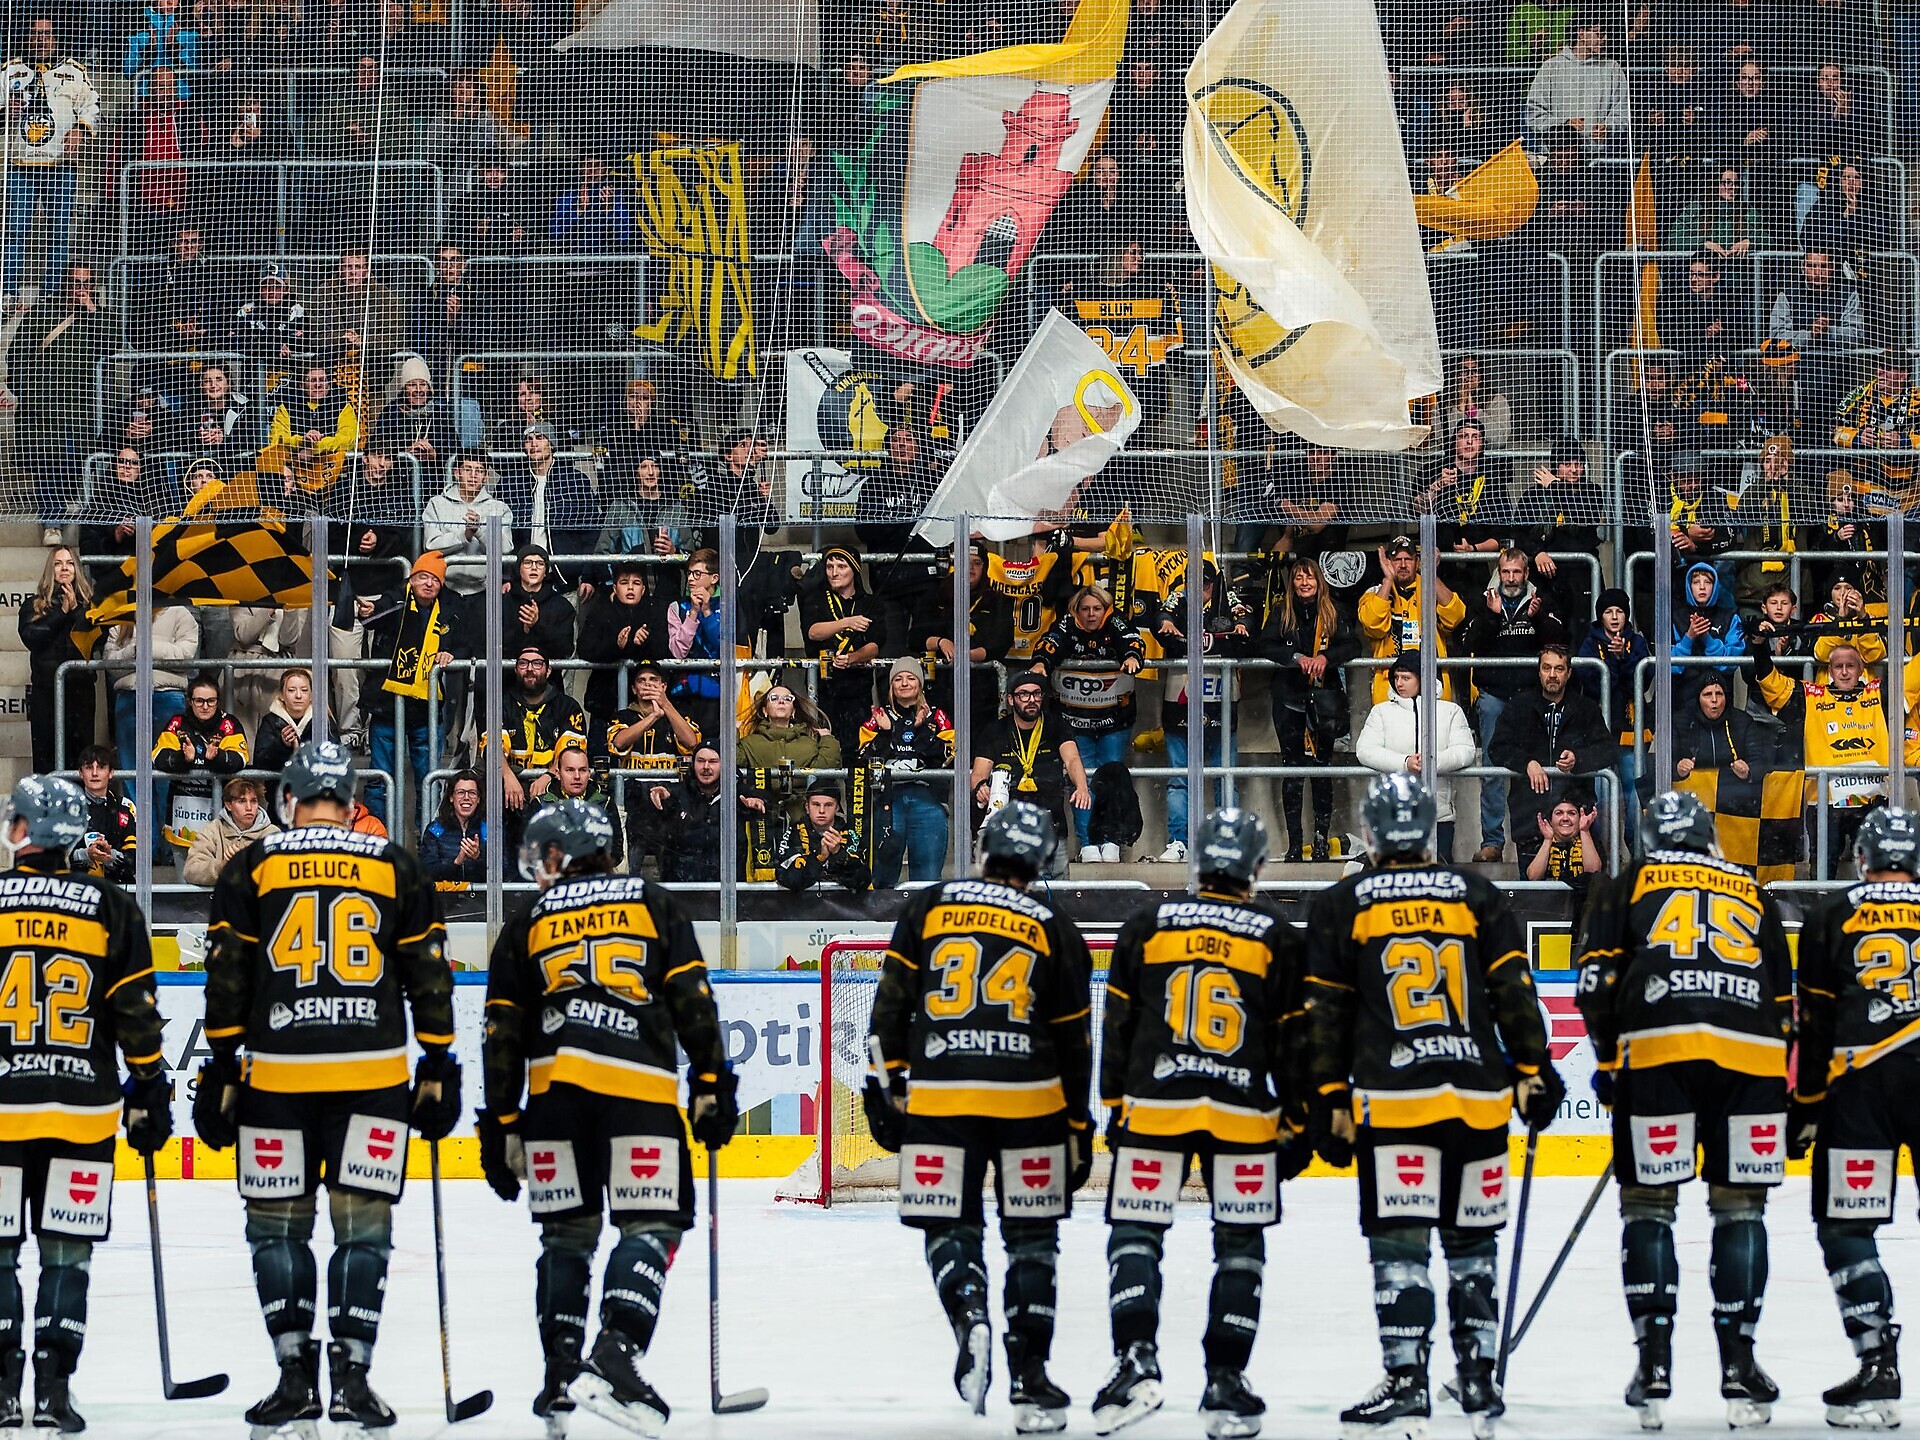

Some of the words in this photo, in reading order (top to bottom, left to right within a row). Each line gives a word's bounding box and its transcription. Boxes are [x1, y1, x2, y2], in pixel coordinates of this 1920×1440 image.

[1100, 302, 1133, 316] BLUM
[1062, 676, 1103, 696] engo
[263, 827, 389, 847] BODNER
[288, 860, 361, 882] DELUCA
[15, 918, 68, 940] TICAR
[548, 910, 630, 939] ZANATTA
[940, 910, 1039, 943] PURDELLER
[1157, 902, 1275, 928] BODNER
[1646, 888, 1763, 969] 45
[267, 891, 384, 987] 46
[1186, 934, 1233, 959] LOBIS
[924, 936, 1037, 1024] 34
[1381, 936, 1471, 1033] 21
[1669, 969, 1761, 1001] SENFTER
[0, 951, 94, 1049] 42
[293, 997, 377, 1024] SENFTER
[1164, 964, 1247, 1057] 16
[565, 997, 639, 1033] ENFTER
[947, 1029, 1032, 1056] SENFTER
[11, 1053, 96, 1078] SENFTER
